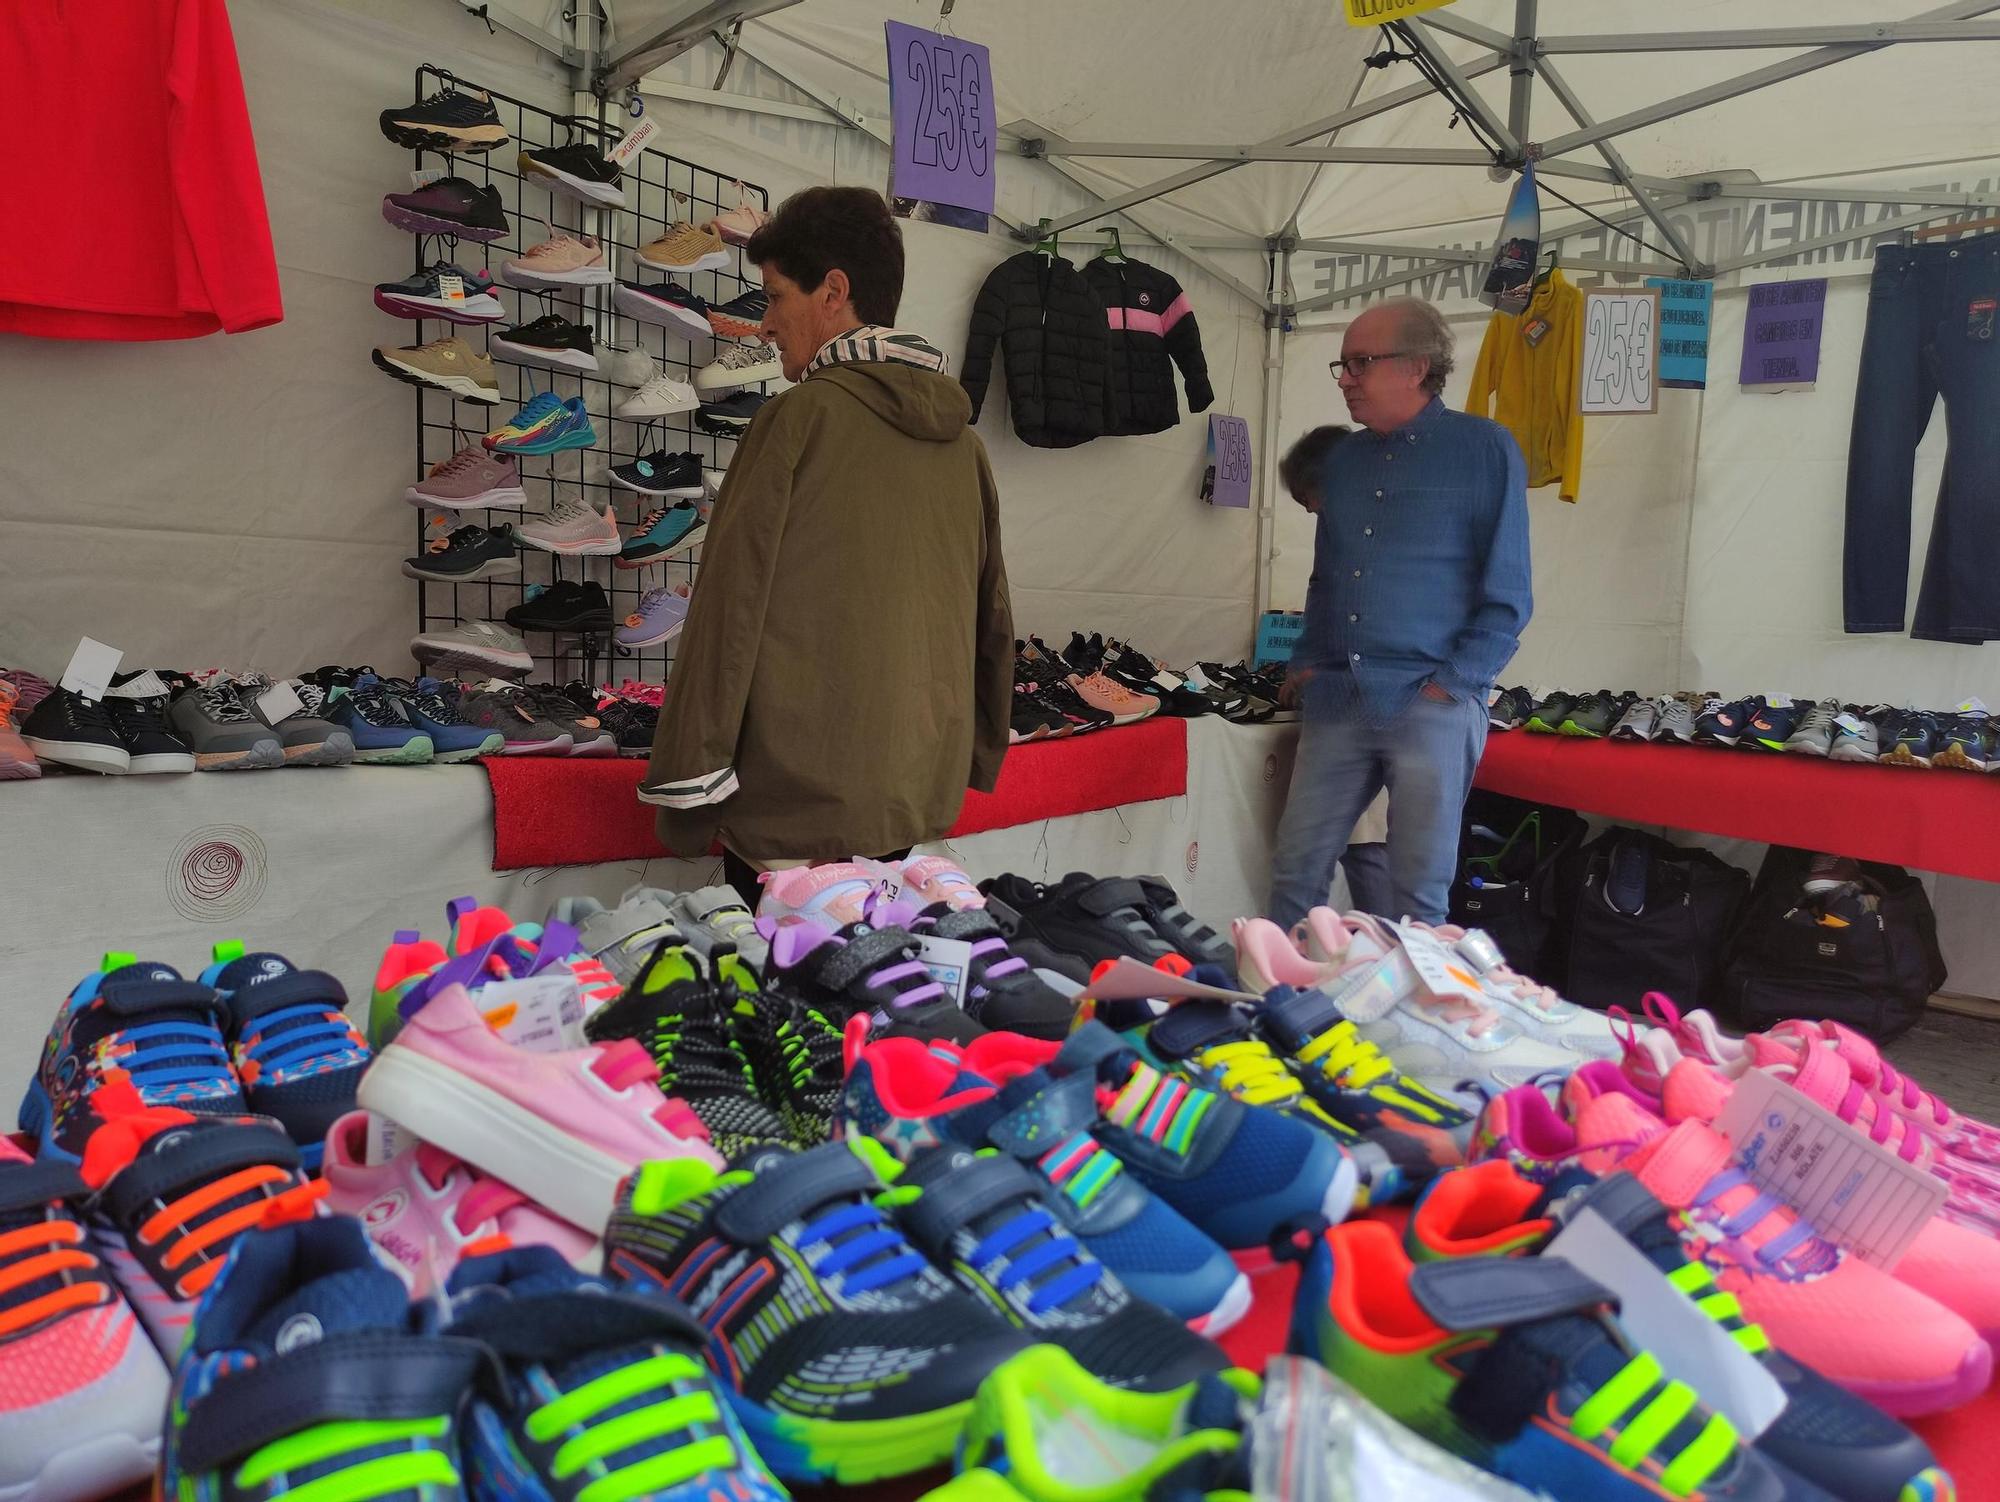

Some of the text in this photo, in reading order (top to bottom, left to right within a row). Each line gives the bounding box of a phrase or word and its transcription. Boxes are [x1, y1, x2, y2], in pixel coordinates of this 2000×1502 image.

[907, 39, 988, 178] 25€
[1586, 299, 1651, 404] 25€
[1219, 419, 1249, 482] 25€
